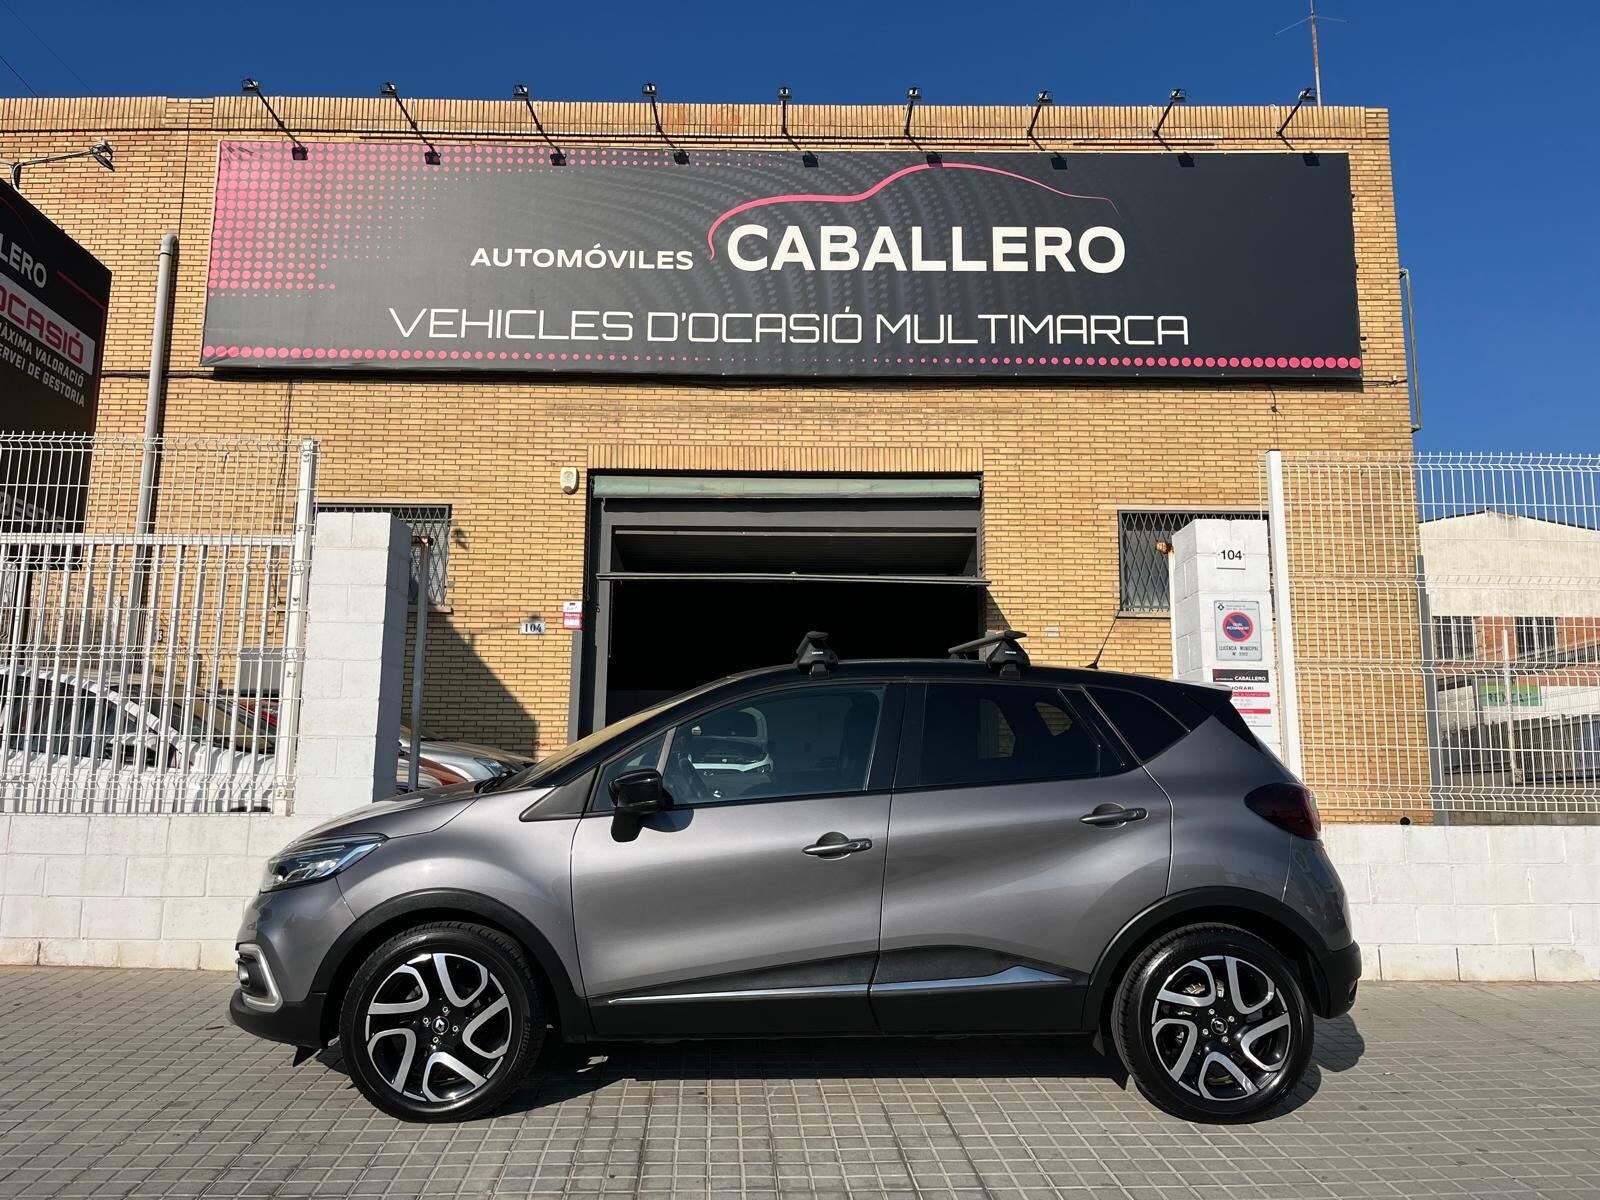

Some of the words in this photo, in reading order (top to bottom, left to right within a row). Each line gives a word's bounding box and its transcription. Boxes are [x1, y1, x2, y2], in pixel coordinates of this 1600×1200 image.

[470, 243, 694, 270] AUTOMÓVILES
[727, 224, 1126, 274] CABALLERO
[388, 307, 634, 342] VEHICLES
[647, 306, 863, 344] D'OCASIÓ
[876, 312, 1189, 346] MULTIMARCA
[0, 321, 33, 356] ÀXIMA
[35, 346, 84, 387] VALORACIÓ
[27, 362, 41, 380] DE
[42, 371, 85, 408] GESTORIA
[1220, 549, 1243, 561] 104
[525, 623, 542, 633] 104
